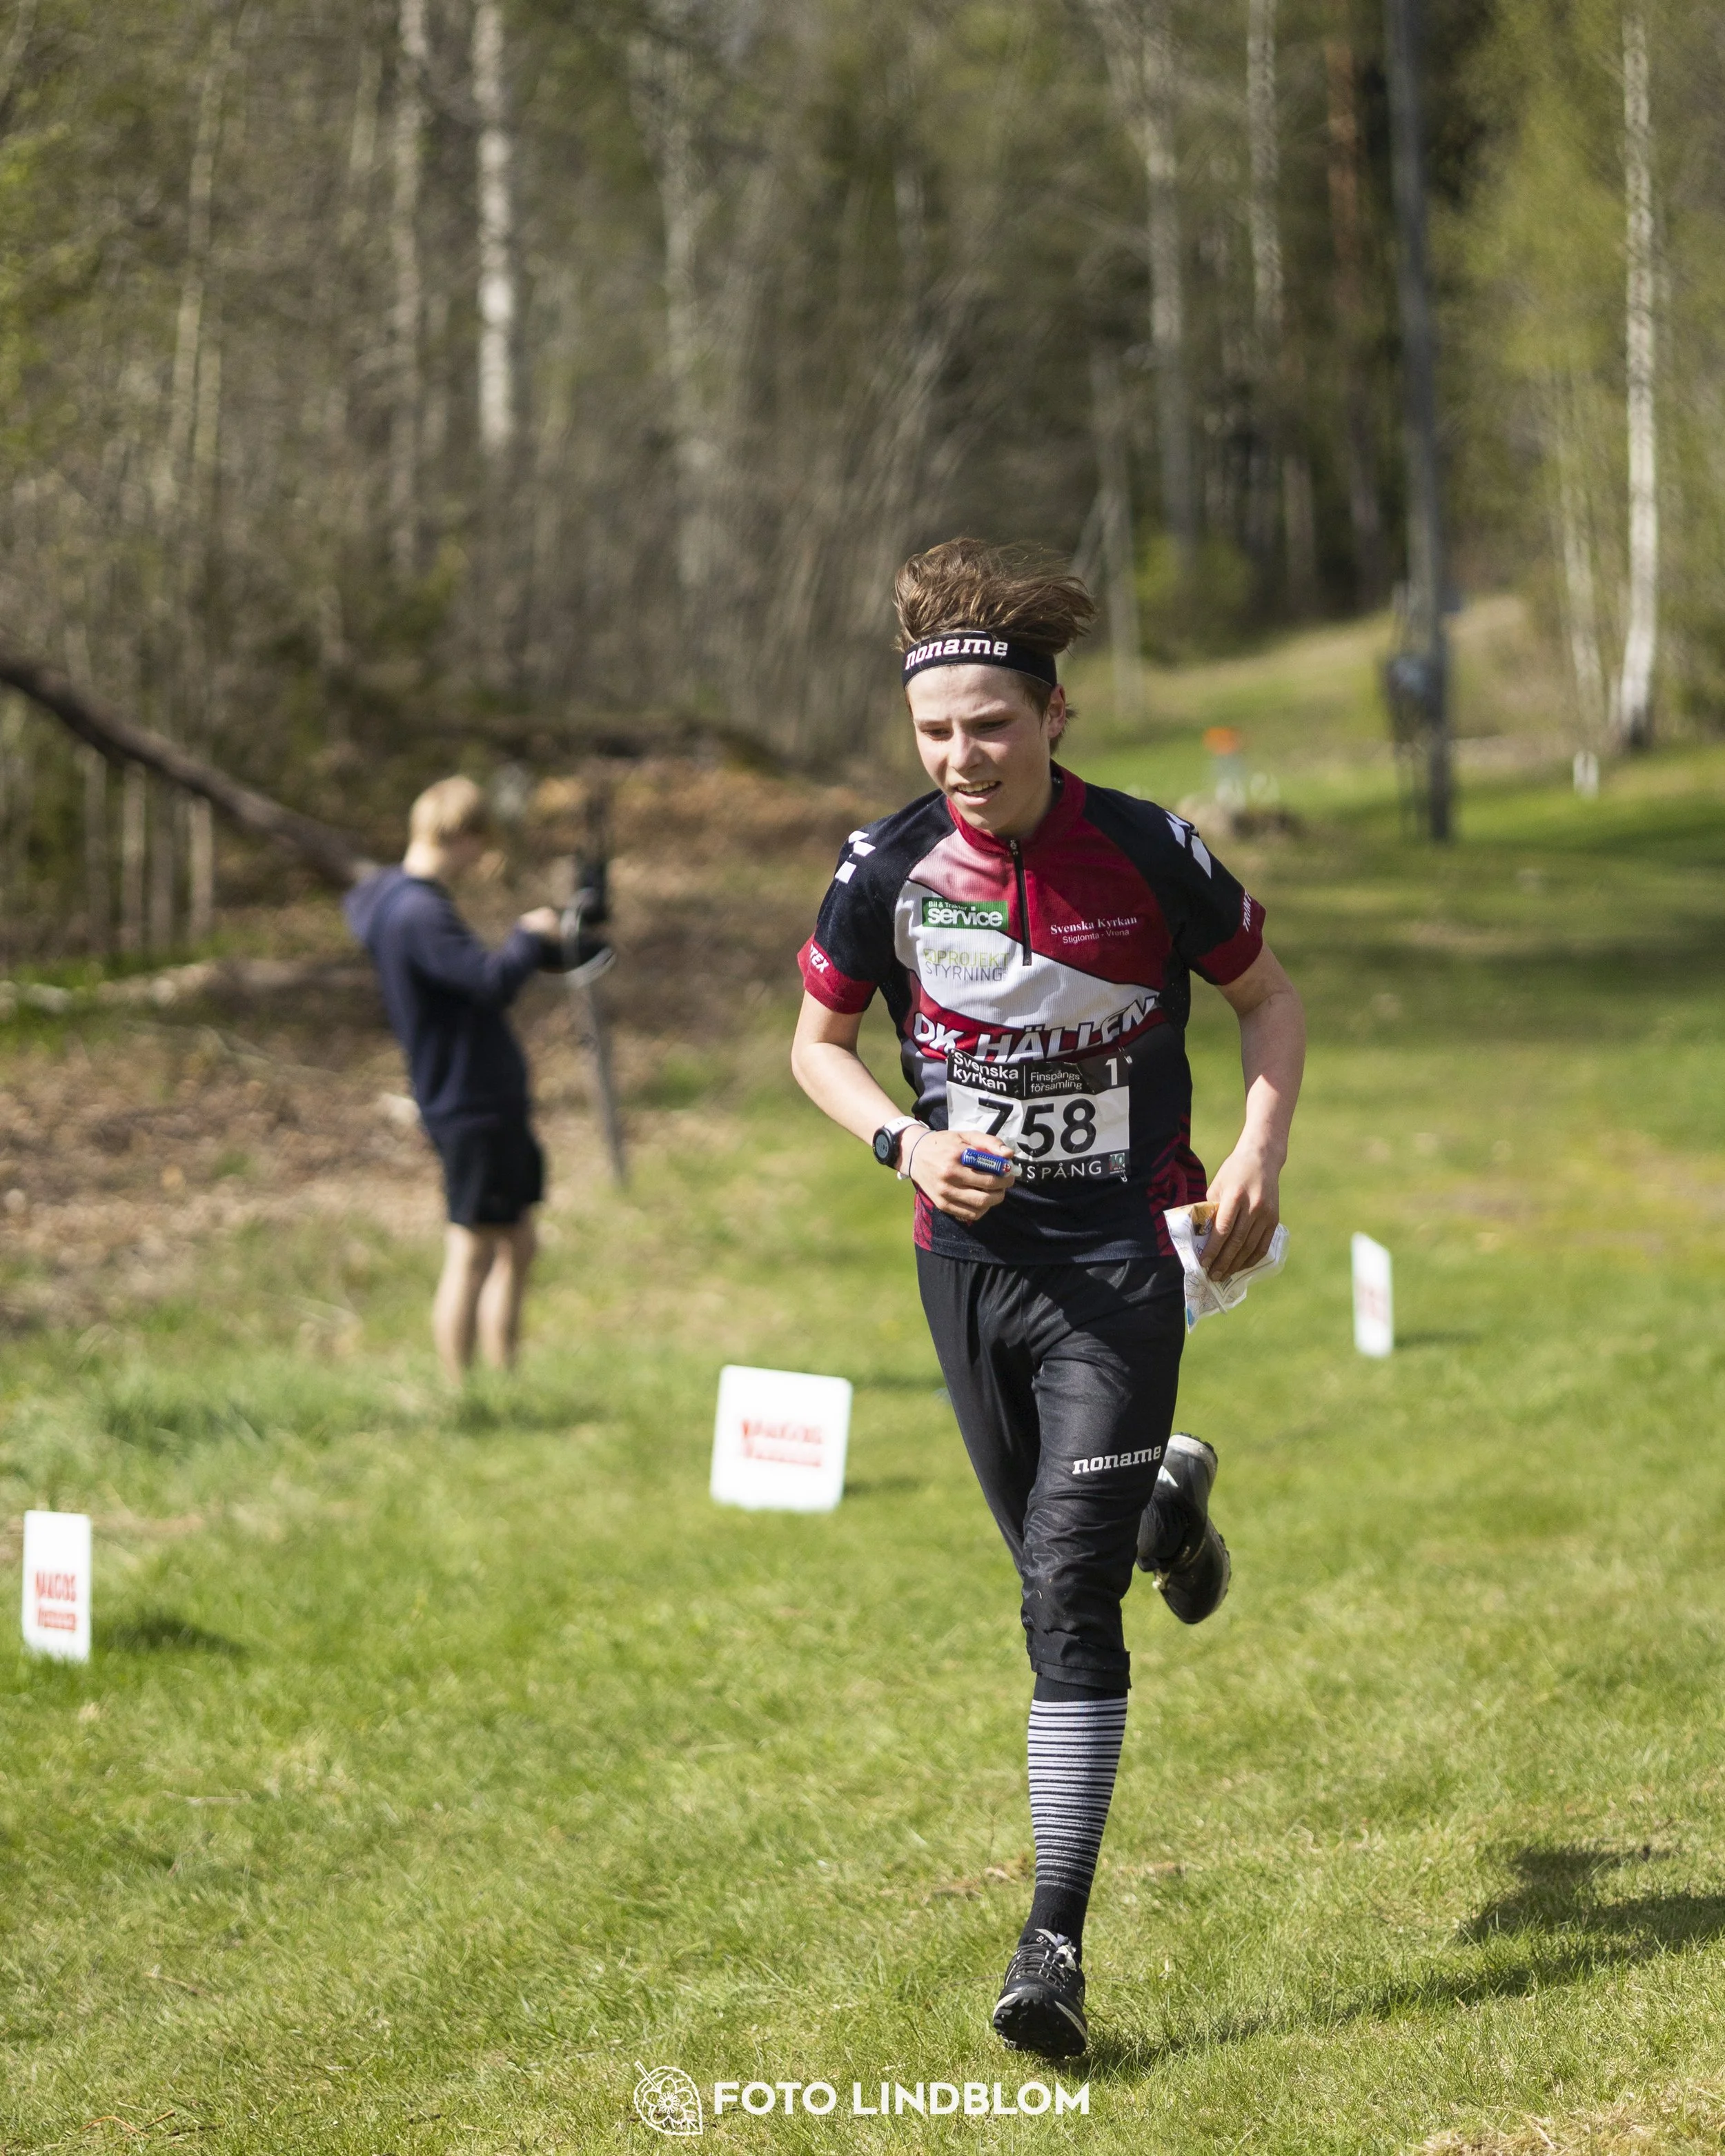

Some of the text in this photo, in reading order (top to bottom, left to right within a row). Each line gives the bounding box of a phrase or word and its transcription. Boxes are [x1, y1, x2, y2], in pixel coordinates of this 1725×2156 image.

[905, 638, 1008, 669] noname
[927, 907, 1003, 927] service
[1050, 917, 1137, 935] Svenska Kyrkan
[1105, 929, 1130, 937] Vrena
[938, 950, 1011, 967] PROJEKT
[925, 960, 1003, 982] STYRNING
[977, 995, 1156, 1063] HÄLLEN
[954, 1054, 1019, 1080] Svenska
[1031, 1070, 1081, 1082] Finspångs
[1105, 1058, 1118, 1086] 1
[953, 1065, 1006, 1092] kyrkan
[1031, 1080, 1083, 1094] församling
[978, 1097, 1097, 1158] 758
[1018, 1160, 1102, 1180] SPÅNG
[1072, 1445, 1162, 1475] noname
